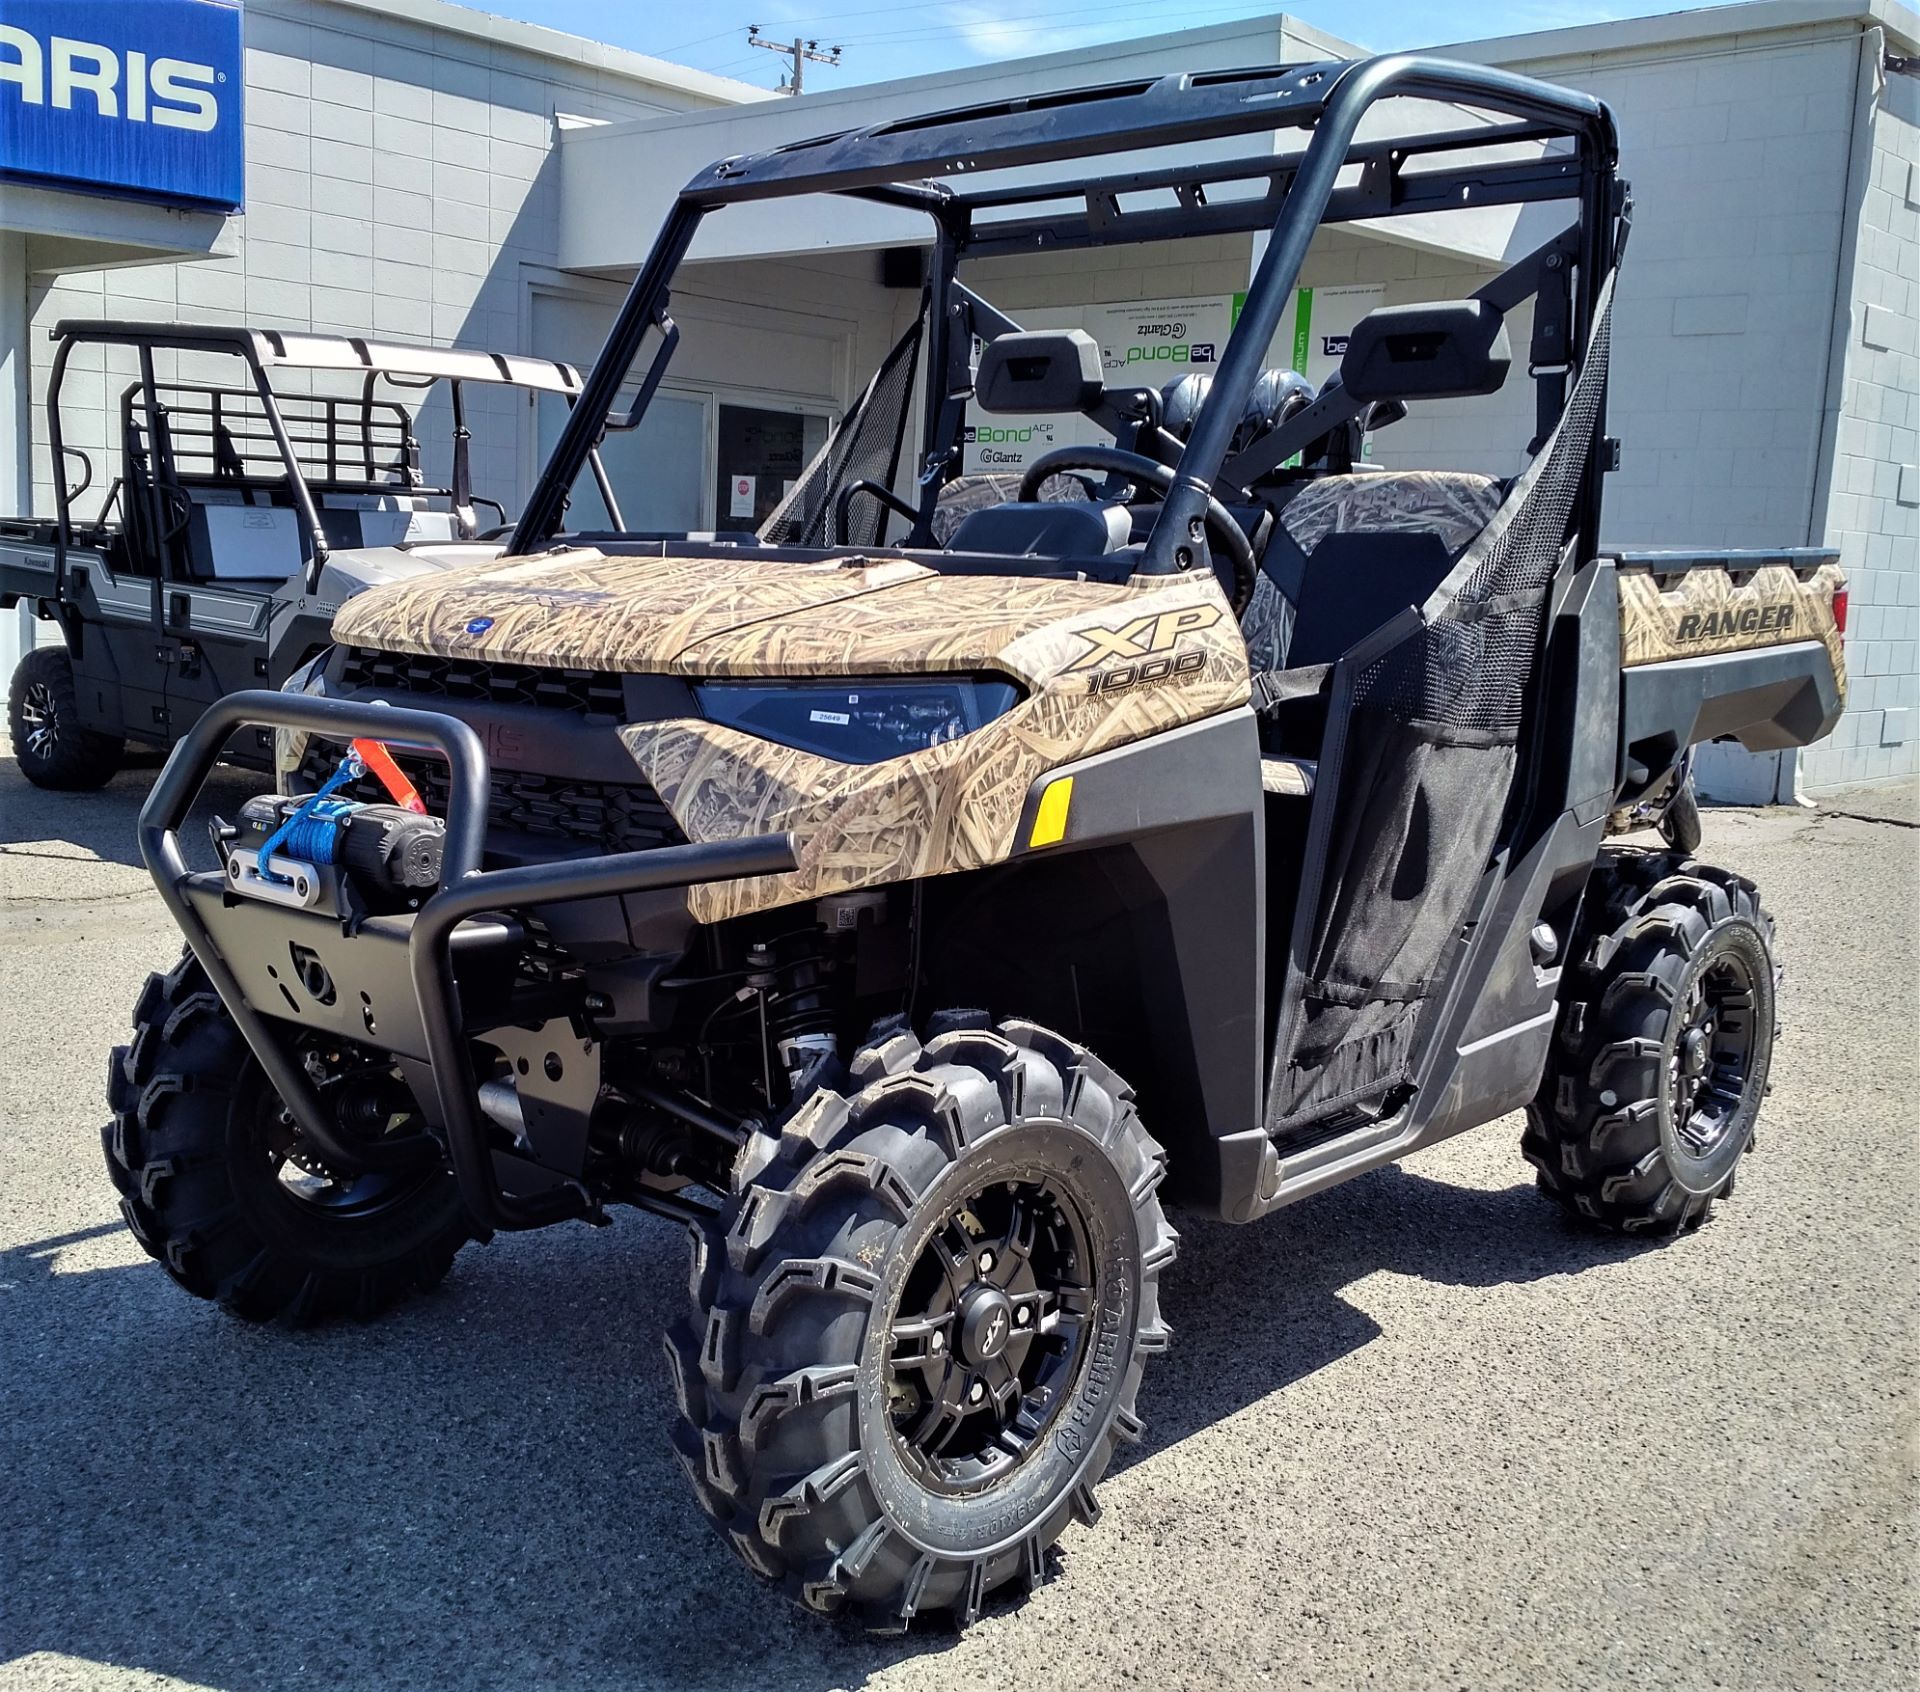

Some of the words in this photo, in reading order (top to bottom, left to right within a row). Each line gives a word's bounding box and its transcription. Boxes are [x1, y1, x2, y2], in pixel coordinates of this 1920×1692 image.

[1137, 323, 1172, 337] Glantz
[1032, 424, 1053, 433] ACP
[992, 451, 1022, 463] Glantz
[1053, 602, 1224, 677] XP
[1676, 604, 1794, 643] RANGER
[1086, 649, 1208, 696] 1000
[1071, 1307, 1122, 1428] ARMOR
